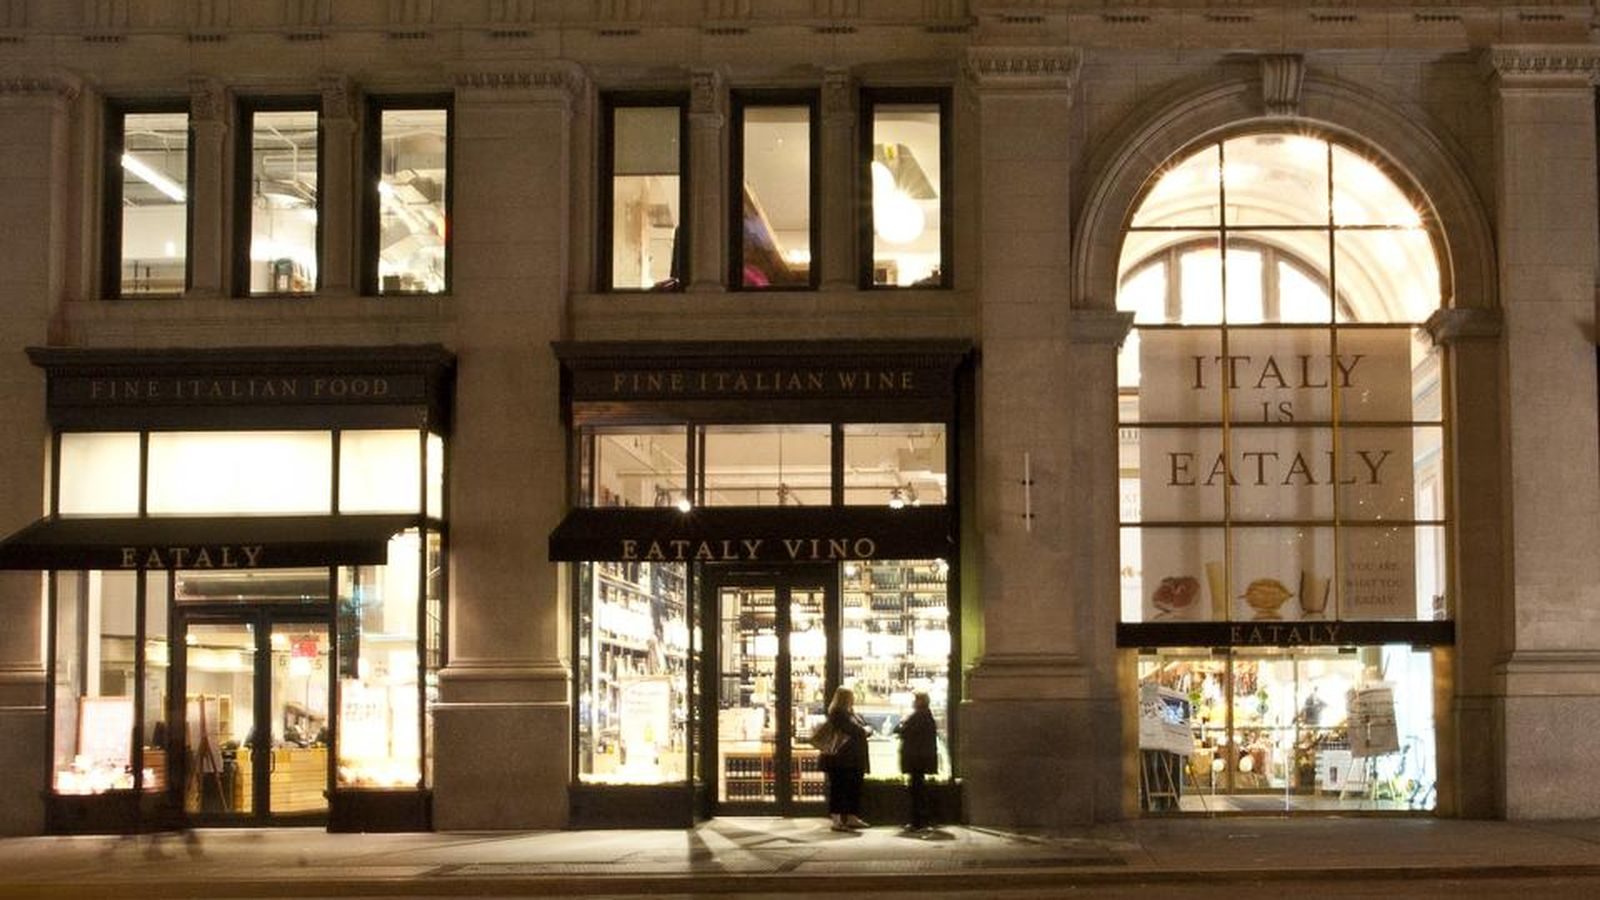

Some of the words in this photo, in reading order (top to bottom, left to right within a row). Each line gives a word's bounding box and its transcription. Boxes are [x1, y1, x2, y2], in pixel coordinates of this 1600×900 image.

[612, 373, 684, 392] FINE
[700, 371, 824, 391] ITALIAN
[839, 371, 915, 390] WINE
[1192, 354, 1365, 389] ITALY
[92, 380, 158, 398] FINE
[176, 379, 298, 397] ITALIAN
[314, 378, 389, 396] FOOD
[1261, 401, 1294, 423] IS
[1166, 451, 1391, 486] EATALY
[121, 546, 263, 568] EATALY
[622, 540, 764, 560] EATALY
[783, 537, 876, 559] VINO
[1231, 626, 1338, 642] EATALY
